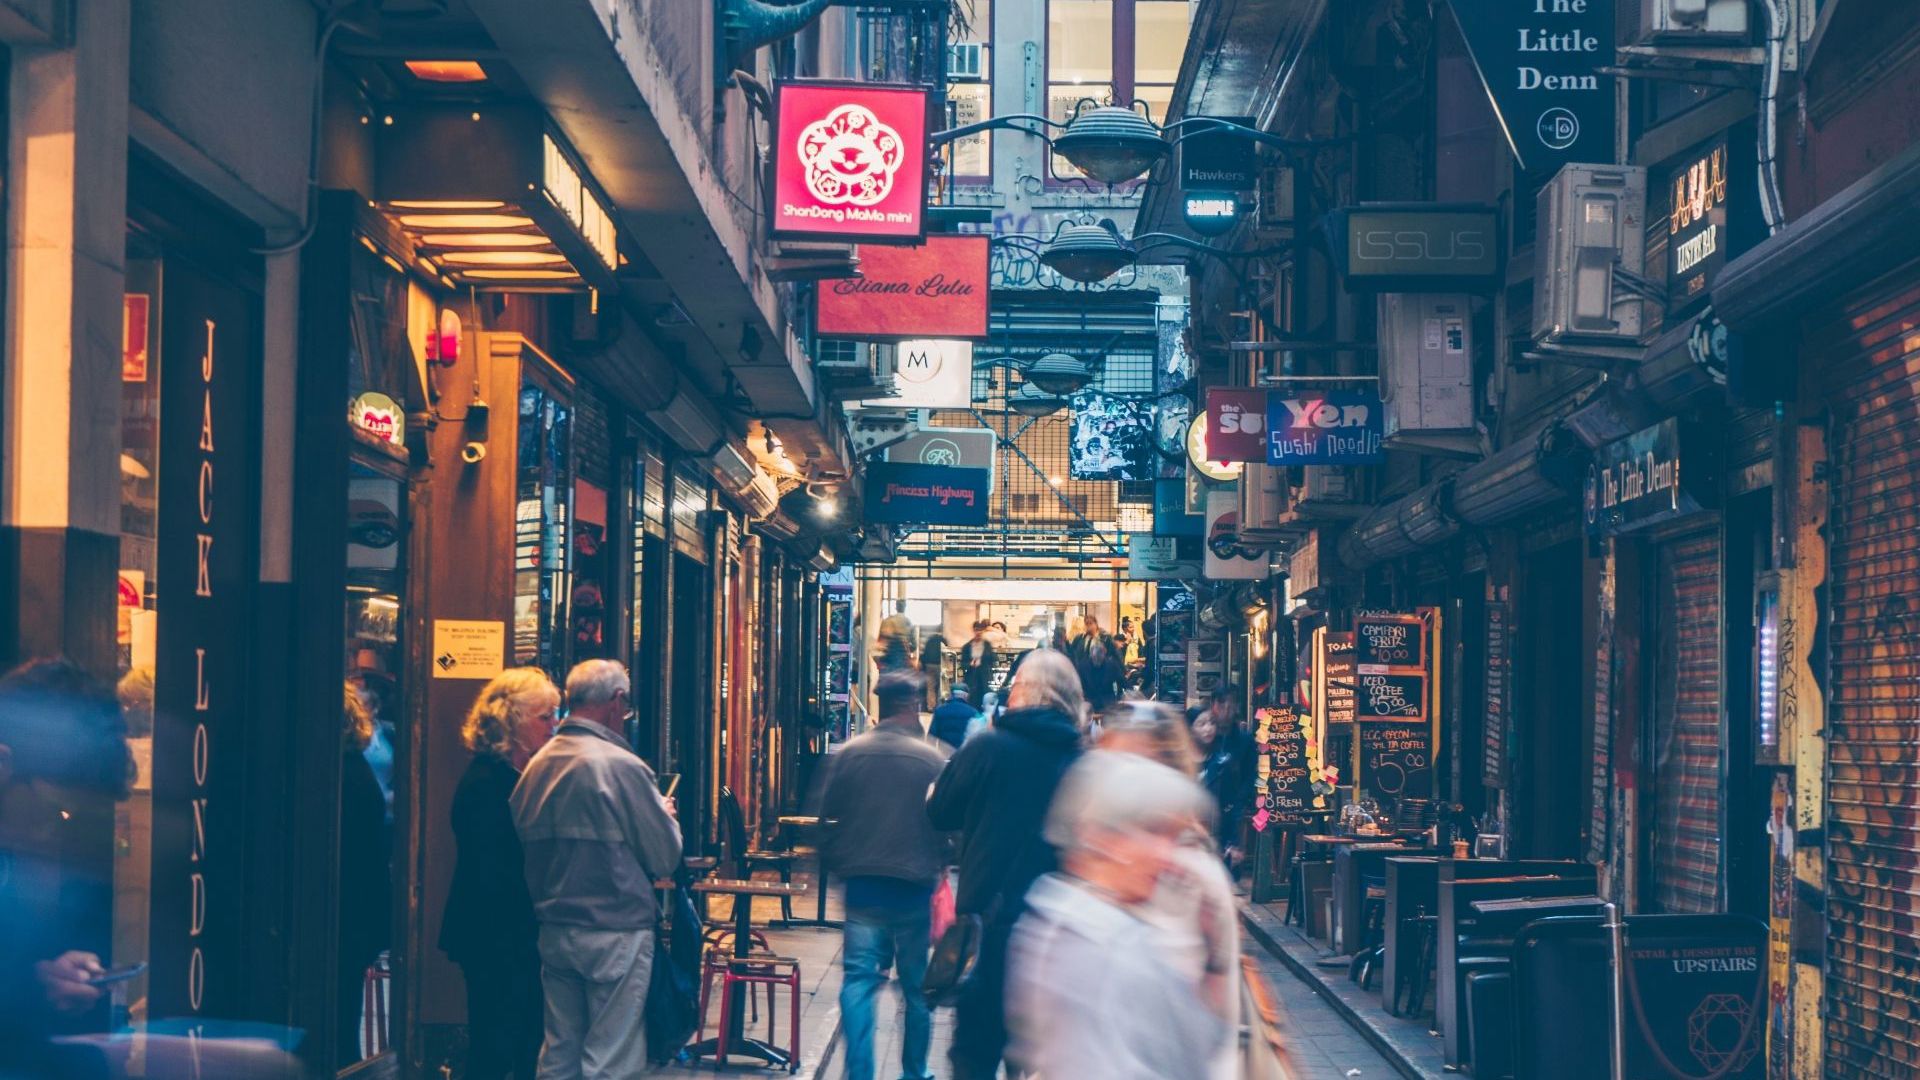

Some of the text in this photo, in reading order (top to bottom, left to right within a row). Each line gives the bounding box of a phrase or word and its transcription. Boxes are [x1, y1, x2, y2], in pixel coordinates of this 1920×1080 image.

[1517, 28, 1599, 52] Little
[1517, 66, 1599, 90] Denn
[1189, 168, 1246, 181] Hawkers
[783, 204, 912, 223] ShanDong MaMa mini
[833, 273, 974, 298] Eliana Lulu
[907, 351, 929, 369] M
[1220, 404, 1240, 413] the
[1280, 398, 1369, 429] Yen
[1271, 430, 1317, 459] Sushi
[196, 319, 215, 597] JACK
[1602, 467, 1618, 509] The
[1620, 457, 1644, 503] Little
[1646, 450, 1672, 494] Denn
[931, 484, 975, 507] Highway
[1362, 625, 1407, 639] CAMPARI
[1363, 675, 1387, 687] ICED
[1369, 685, 1405, 697] COFFEE
[1276, 796, 1303, 807] FRESH
[1673, 957, 1757, 973] UPSTAIRS
